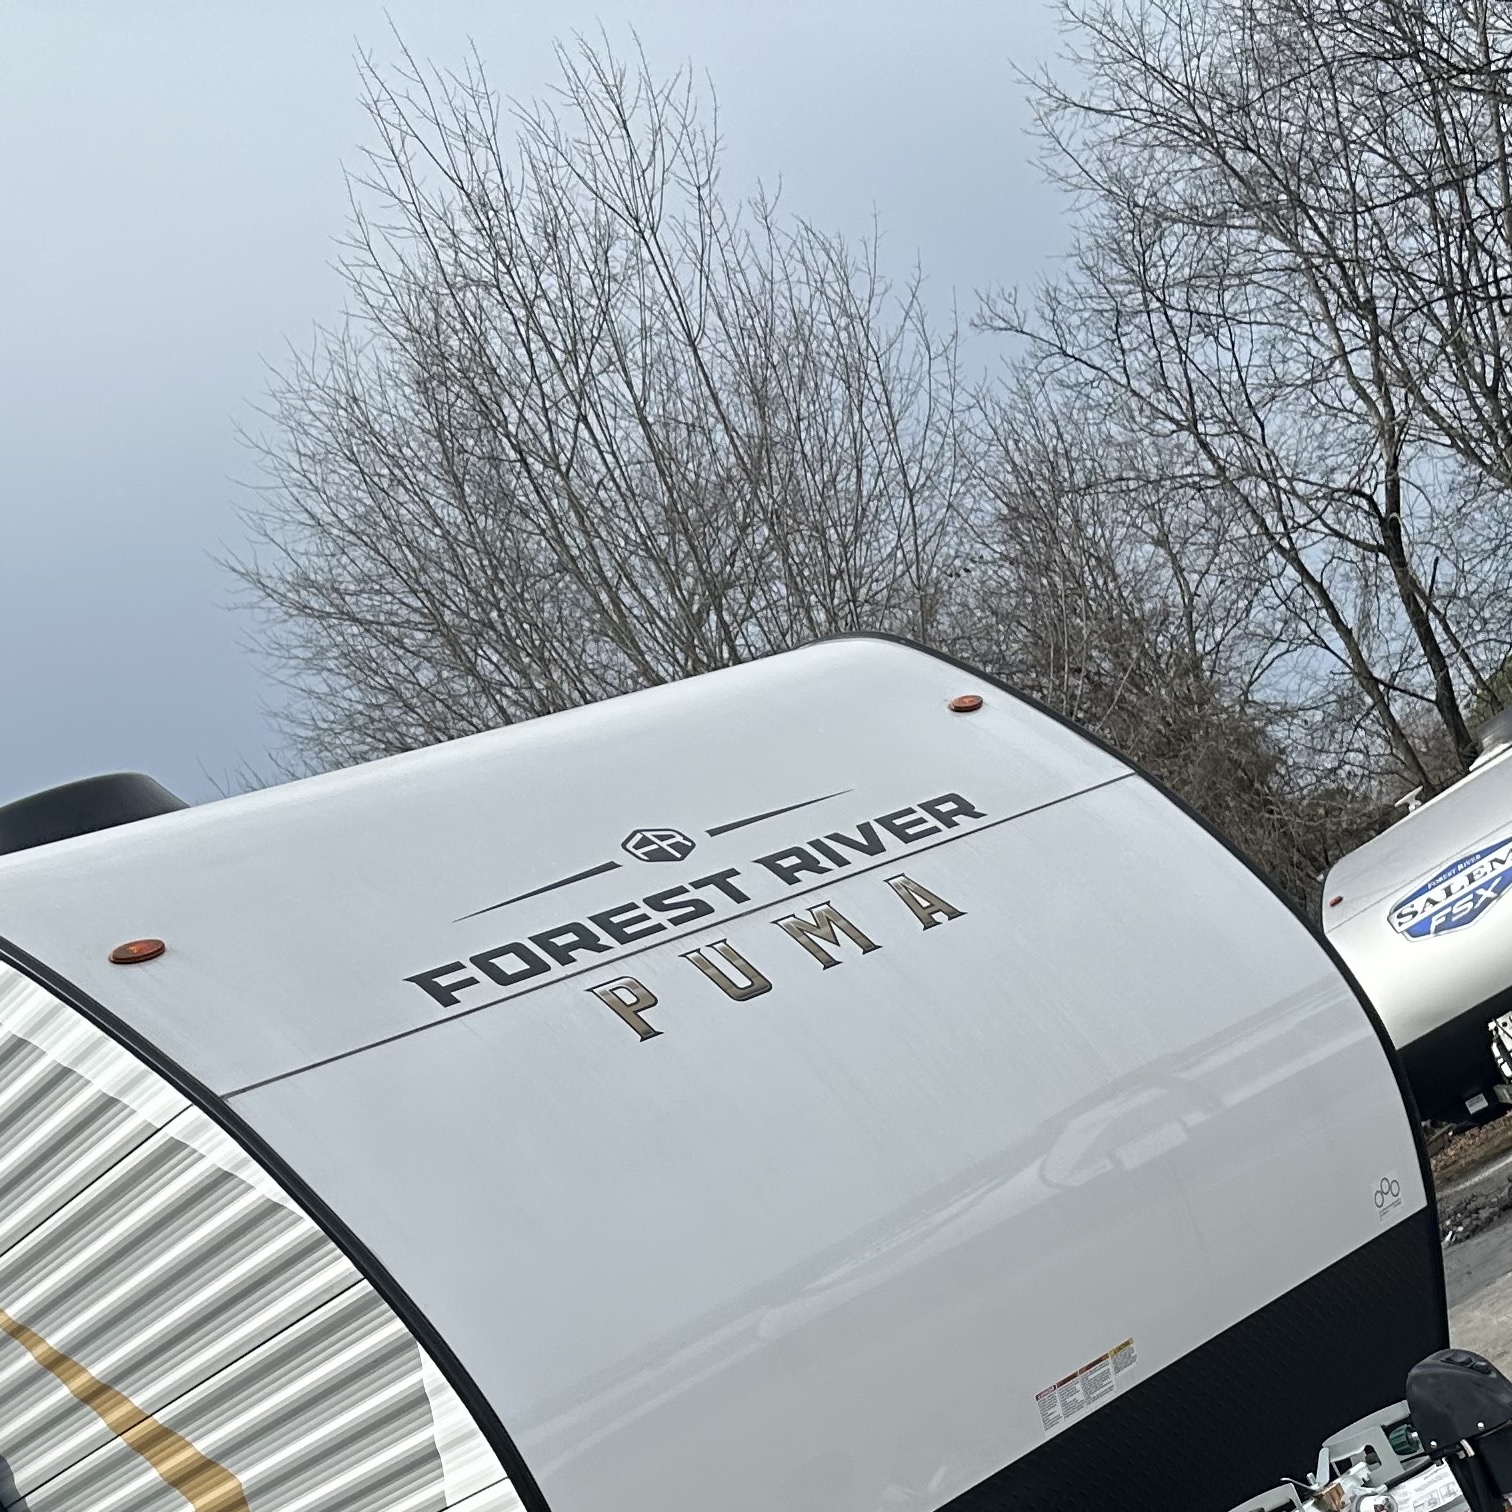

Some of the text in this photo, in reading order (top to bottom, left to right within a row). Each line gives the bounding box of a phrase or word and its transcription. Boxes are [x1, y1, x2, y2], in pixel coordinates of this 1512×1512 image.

[402, 791, 988, 1009] FOREST RIVER
[584, 873, 968, 1043] PUMA
[1429, 876, 1502, 935] FSX
